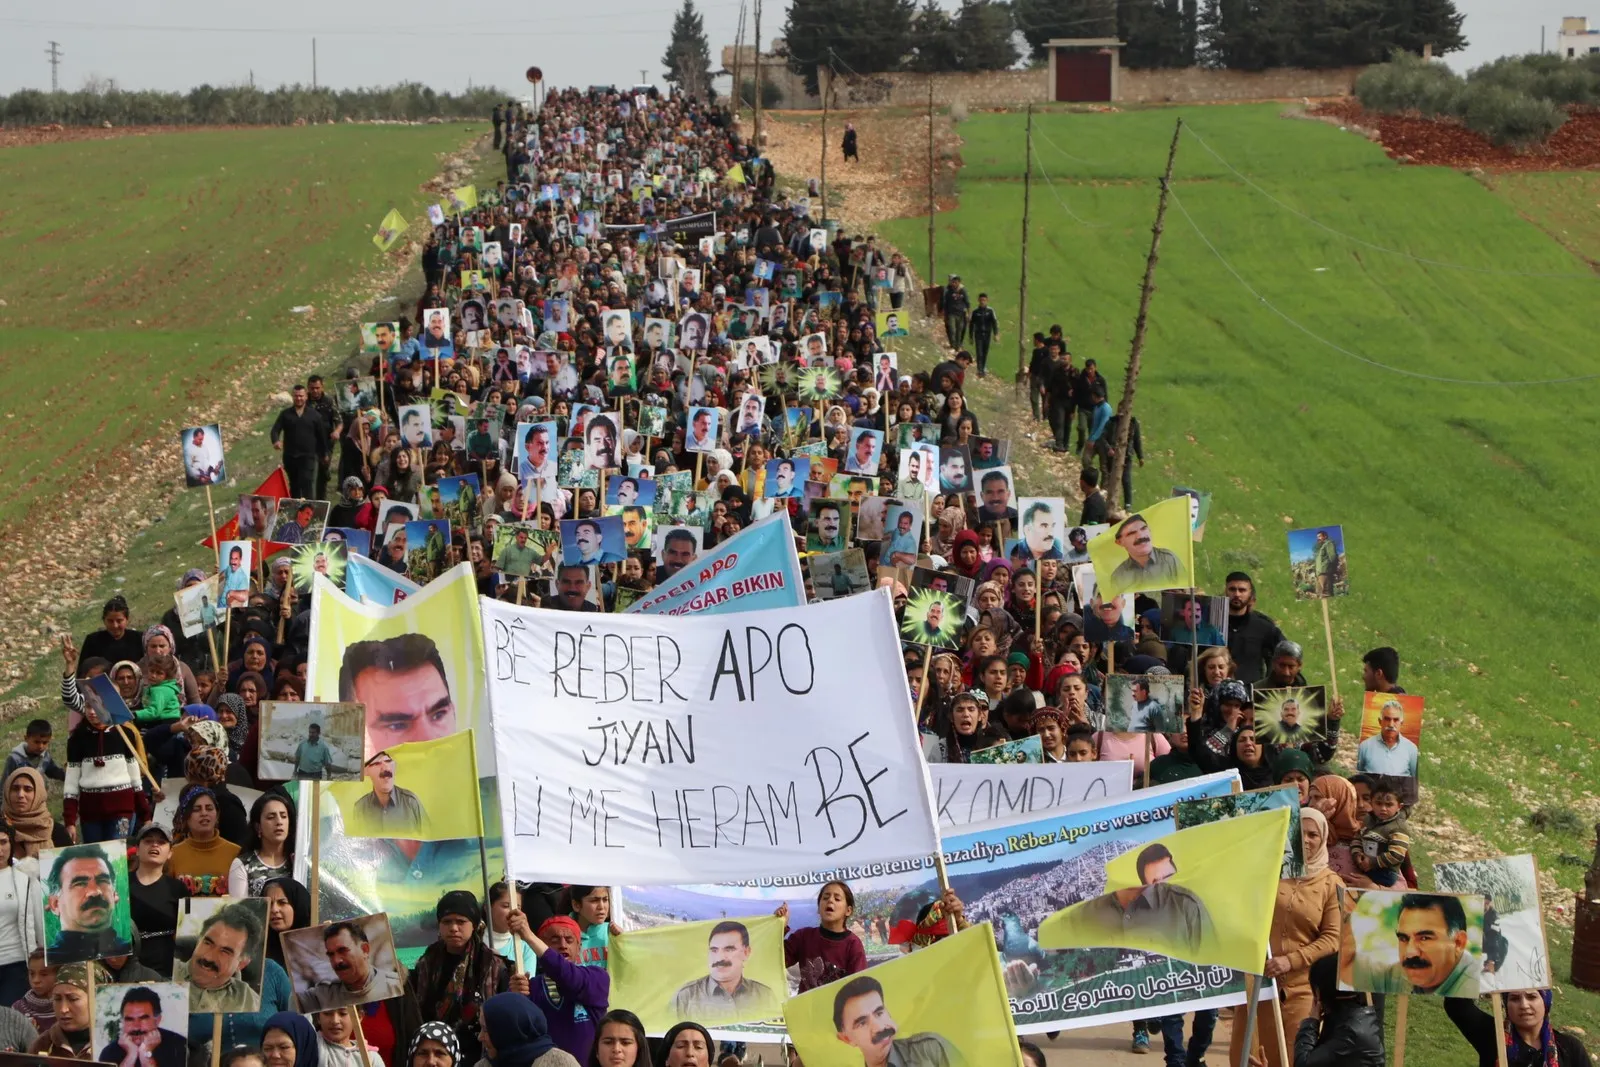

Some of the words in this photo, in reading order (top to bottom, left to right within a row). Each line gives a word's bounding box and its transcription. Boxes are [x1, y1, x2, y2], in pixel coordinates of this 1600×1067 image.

[700, 553, 738, 583] APO
[732, 571, 784, 597] BIKIN
[495, 617, 530, 684] BÊ
[550, 625, 688, 703] RÊBER
[709, 623, 814, 701] APO
[569, 787, 625, 848] ME
[651, 780, 802, 848] HERAM
[804, 731, 908, 856] BE
[943, 841, 1005, 866] azadiya
[1007, 831, 1057, 855] Rêber
[1059, 822, 1091, 845] Apo
[1091, 818, 1110, 834] re
[1110, 808, 1151, 831] were
[1140, 969, 1206, 1000] يكتمل
[1208, 965, 1233, 987] لن
[1062, 980, 1135, 1012] مشروع
